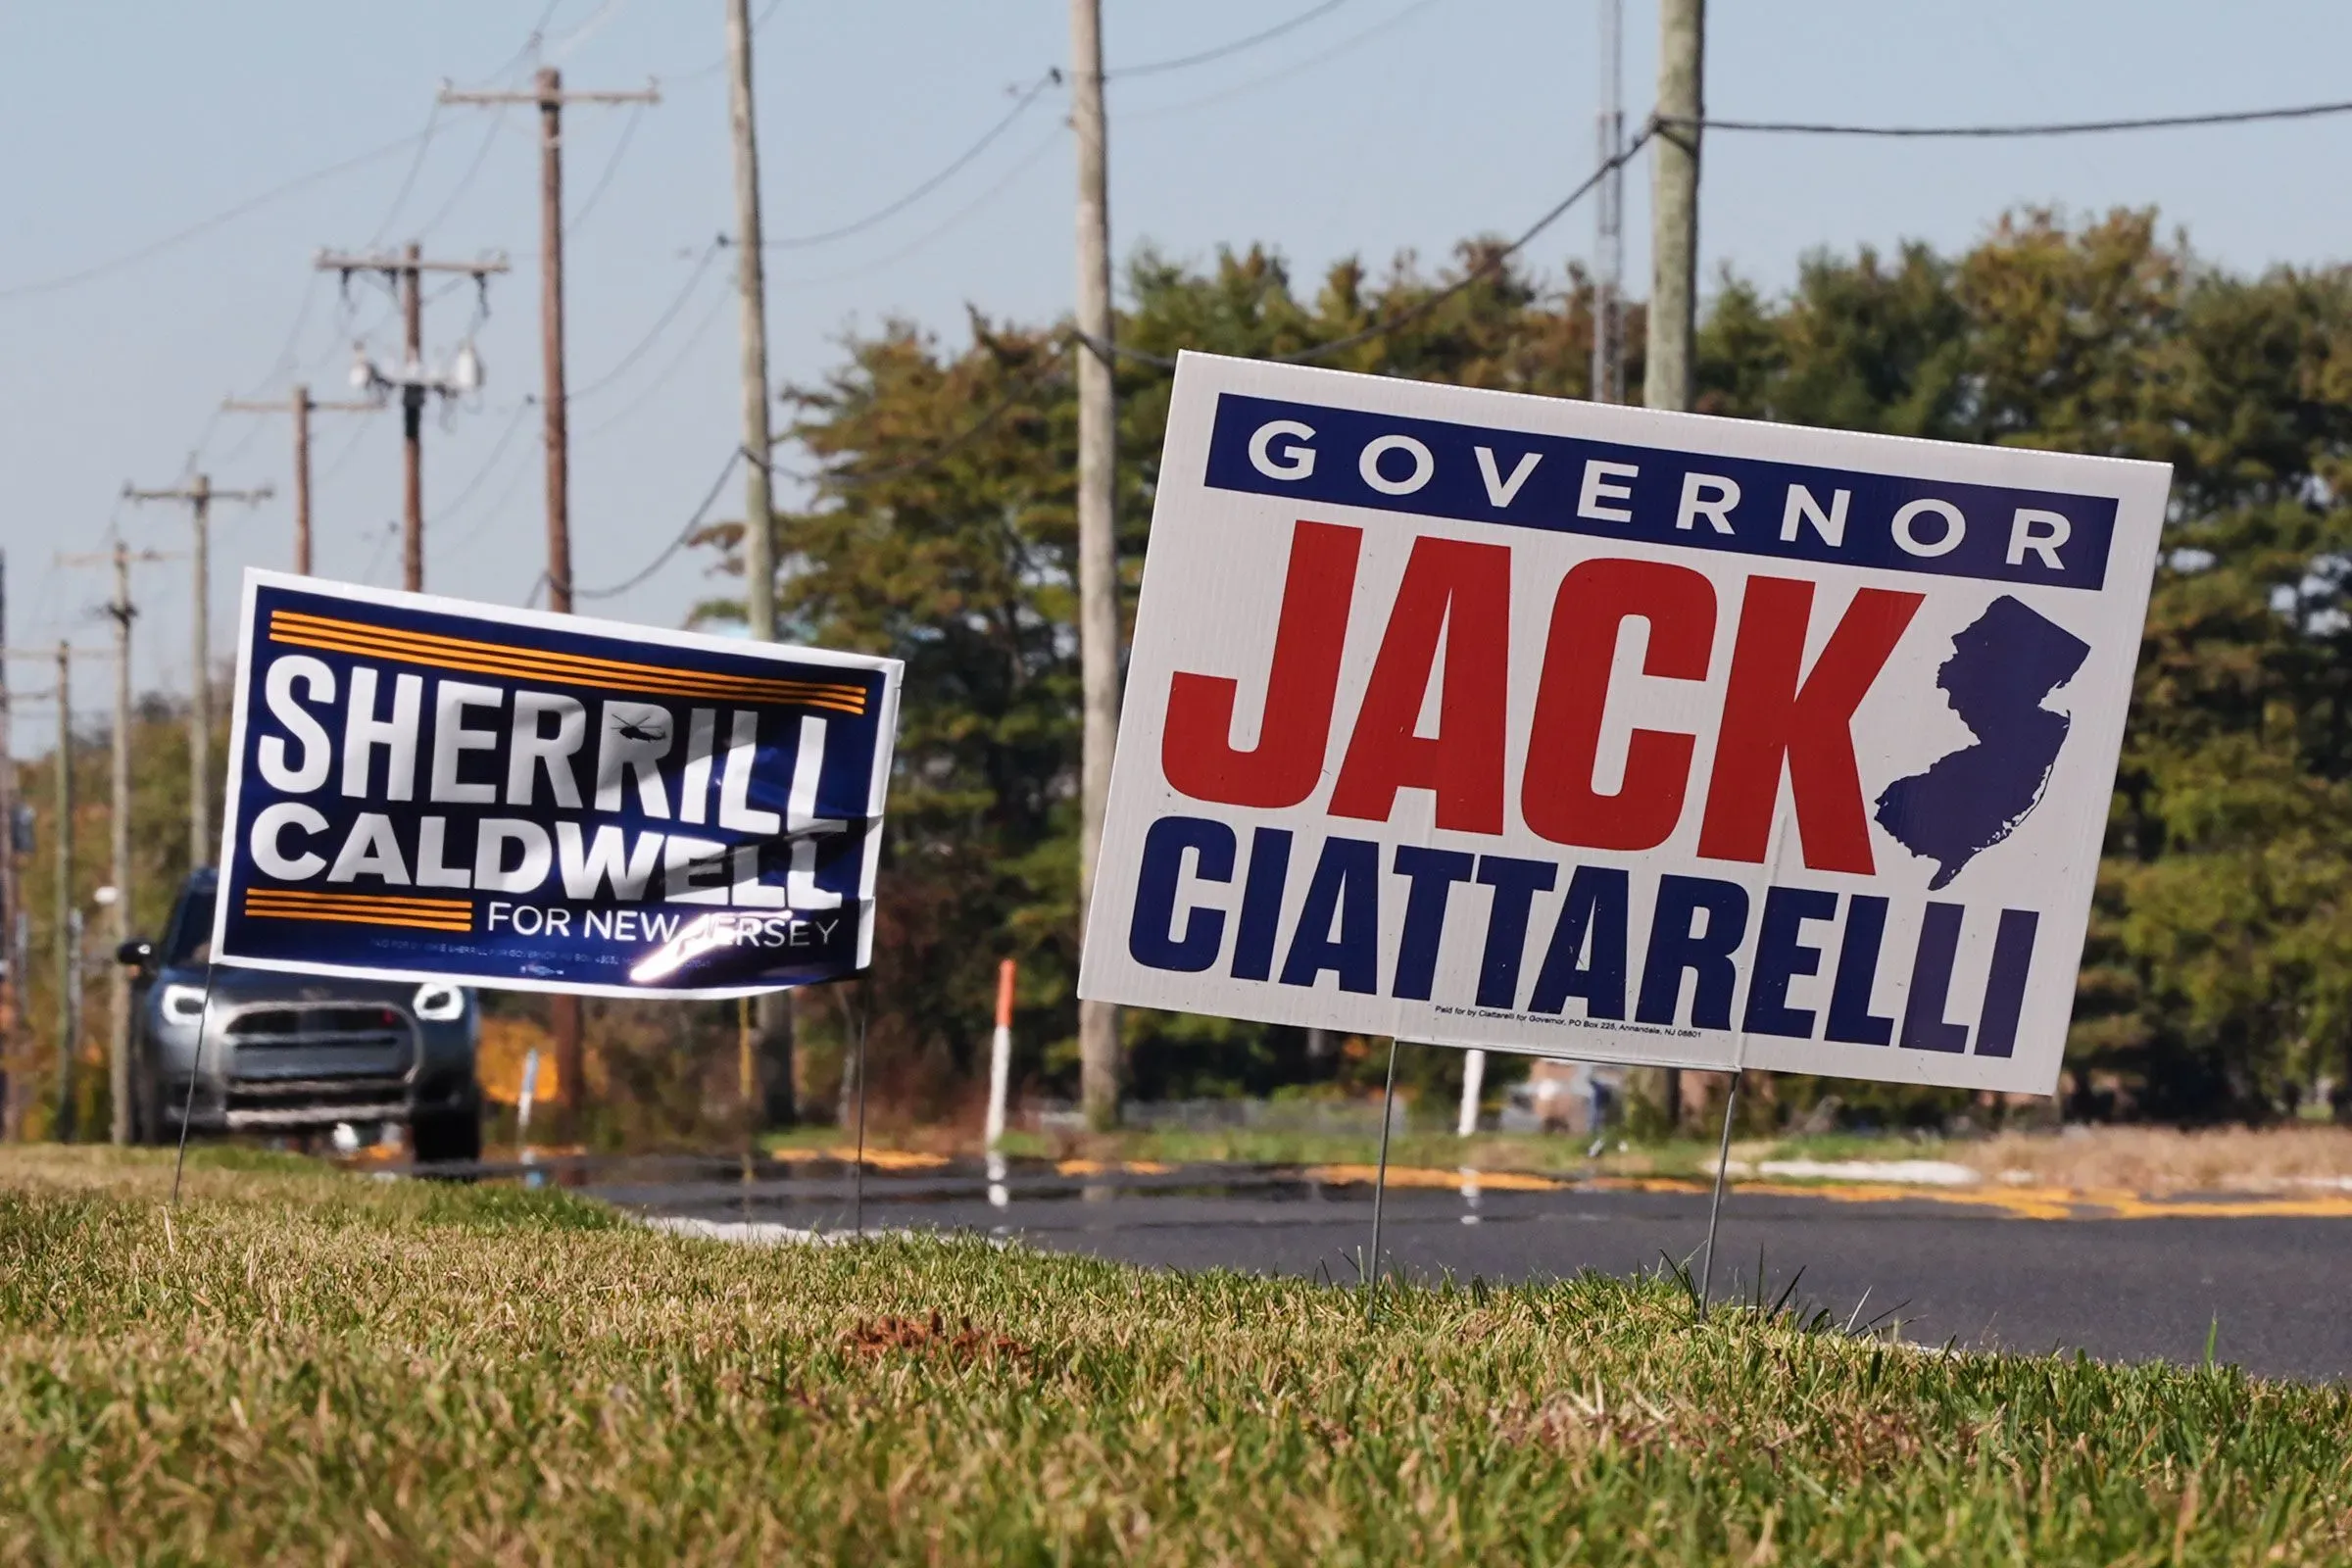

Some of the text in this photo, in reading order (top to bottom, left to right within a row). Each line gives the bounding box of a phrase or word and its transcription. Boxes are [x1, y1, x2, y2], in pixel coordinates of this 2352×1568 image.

[1248, 419, 2072, 570] GOVERNOR
[257, 655, 848, 835] SHERRILL
[1161, 519, 1926, 876] JACK
[249, 802, 843, 910] CALDWELL
[488, 901, 571, 938] FOR
[583, 909, 680, 944] NEW
[1129, 816, 2040, 1058] CIATTARELLI
[1435, 1005, 1453, 1014] Paid
[1454, 1006, 1465, 1015] for
[1467, 1008, 1477, 1017] by
[1478, 1009, 1515, 1020] Ciattarelli
[1529, 1014, 1567, 1026] Governor,
[1568, 1018, 1583, 1027] PO
[1583, 1020, 1598, 1029] Box
[1619, 1024, 1663, 1035] Annandale,
